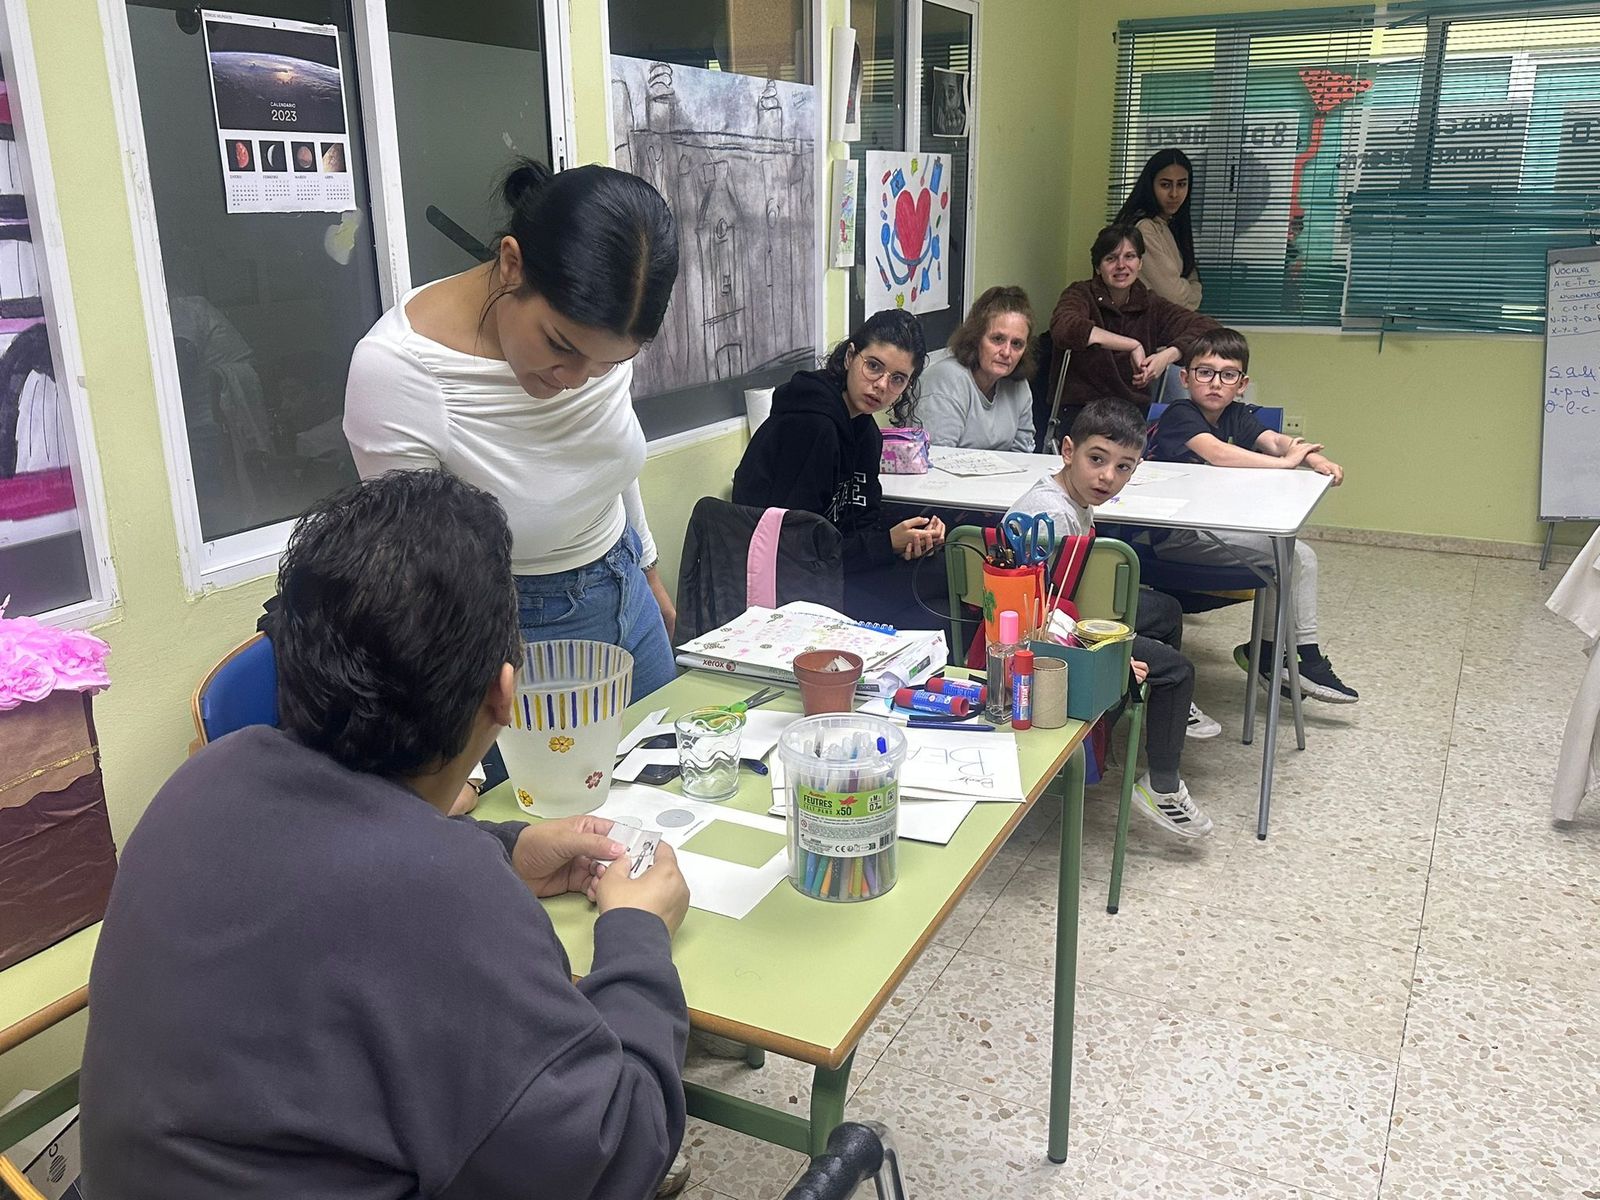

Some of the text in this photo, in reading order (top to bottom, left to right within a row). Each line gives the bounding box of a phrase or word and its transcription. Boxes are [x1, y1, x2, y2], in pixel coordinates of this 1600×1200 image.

[270, 109, 297, 122] 2023
[702, 659, 725, 669] xerox
[803, 795, 833, 809] FEUTRES
[836, 807, 852, 816] x50
